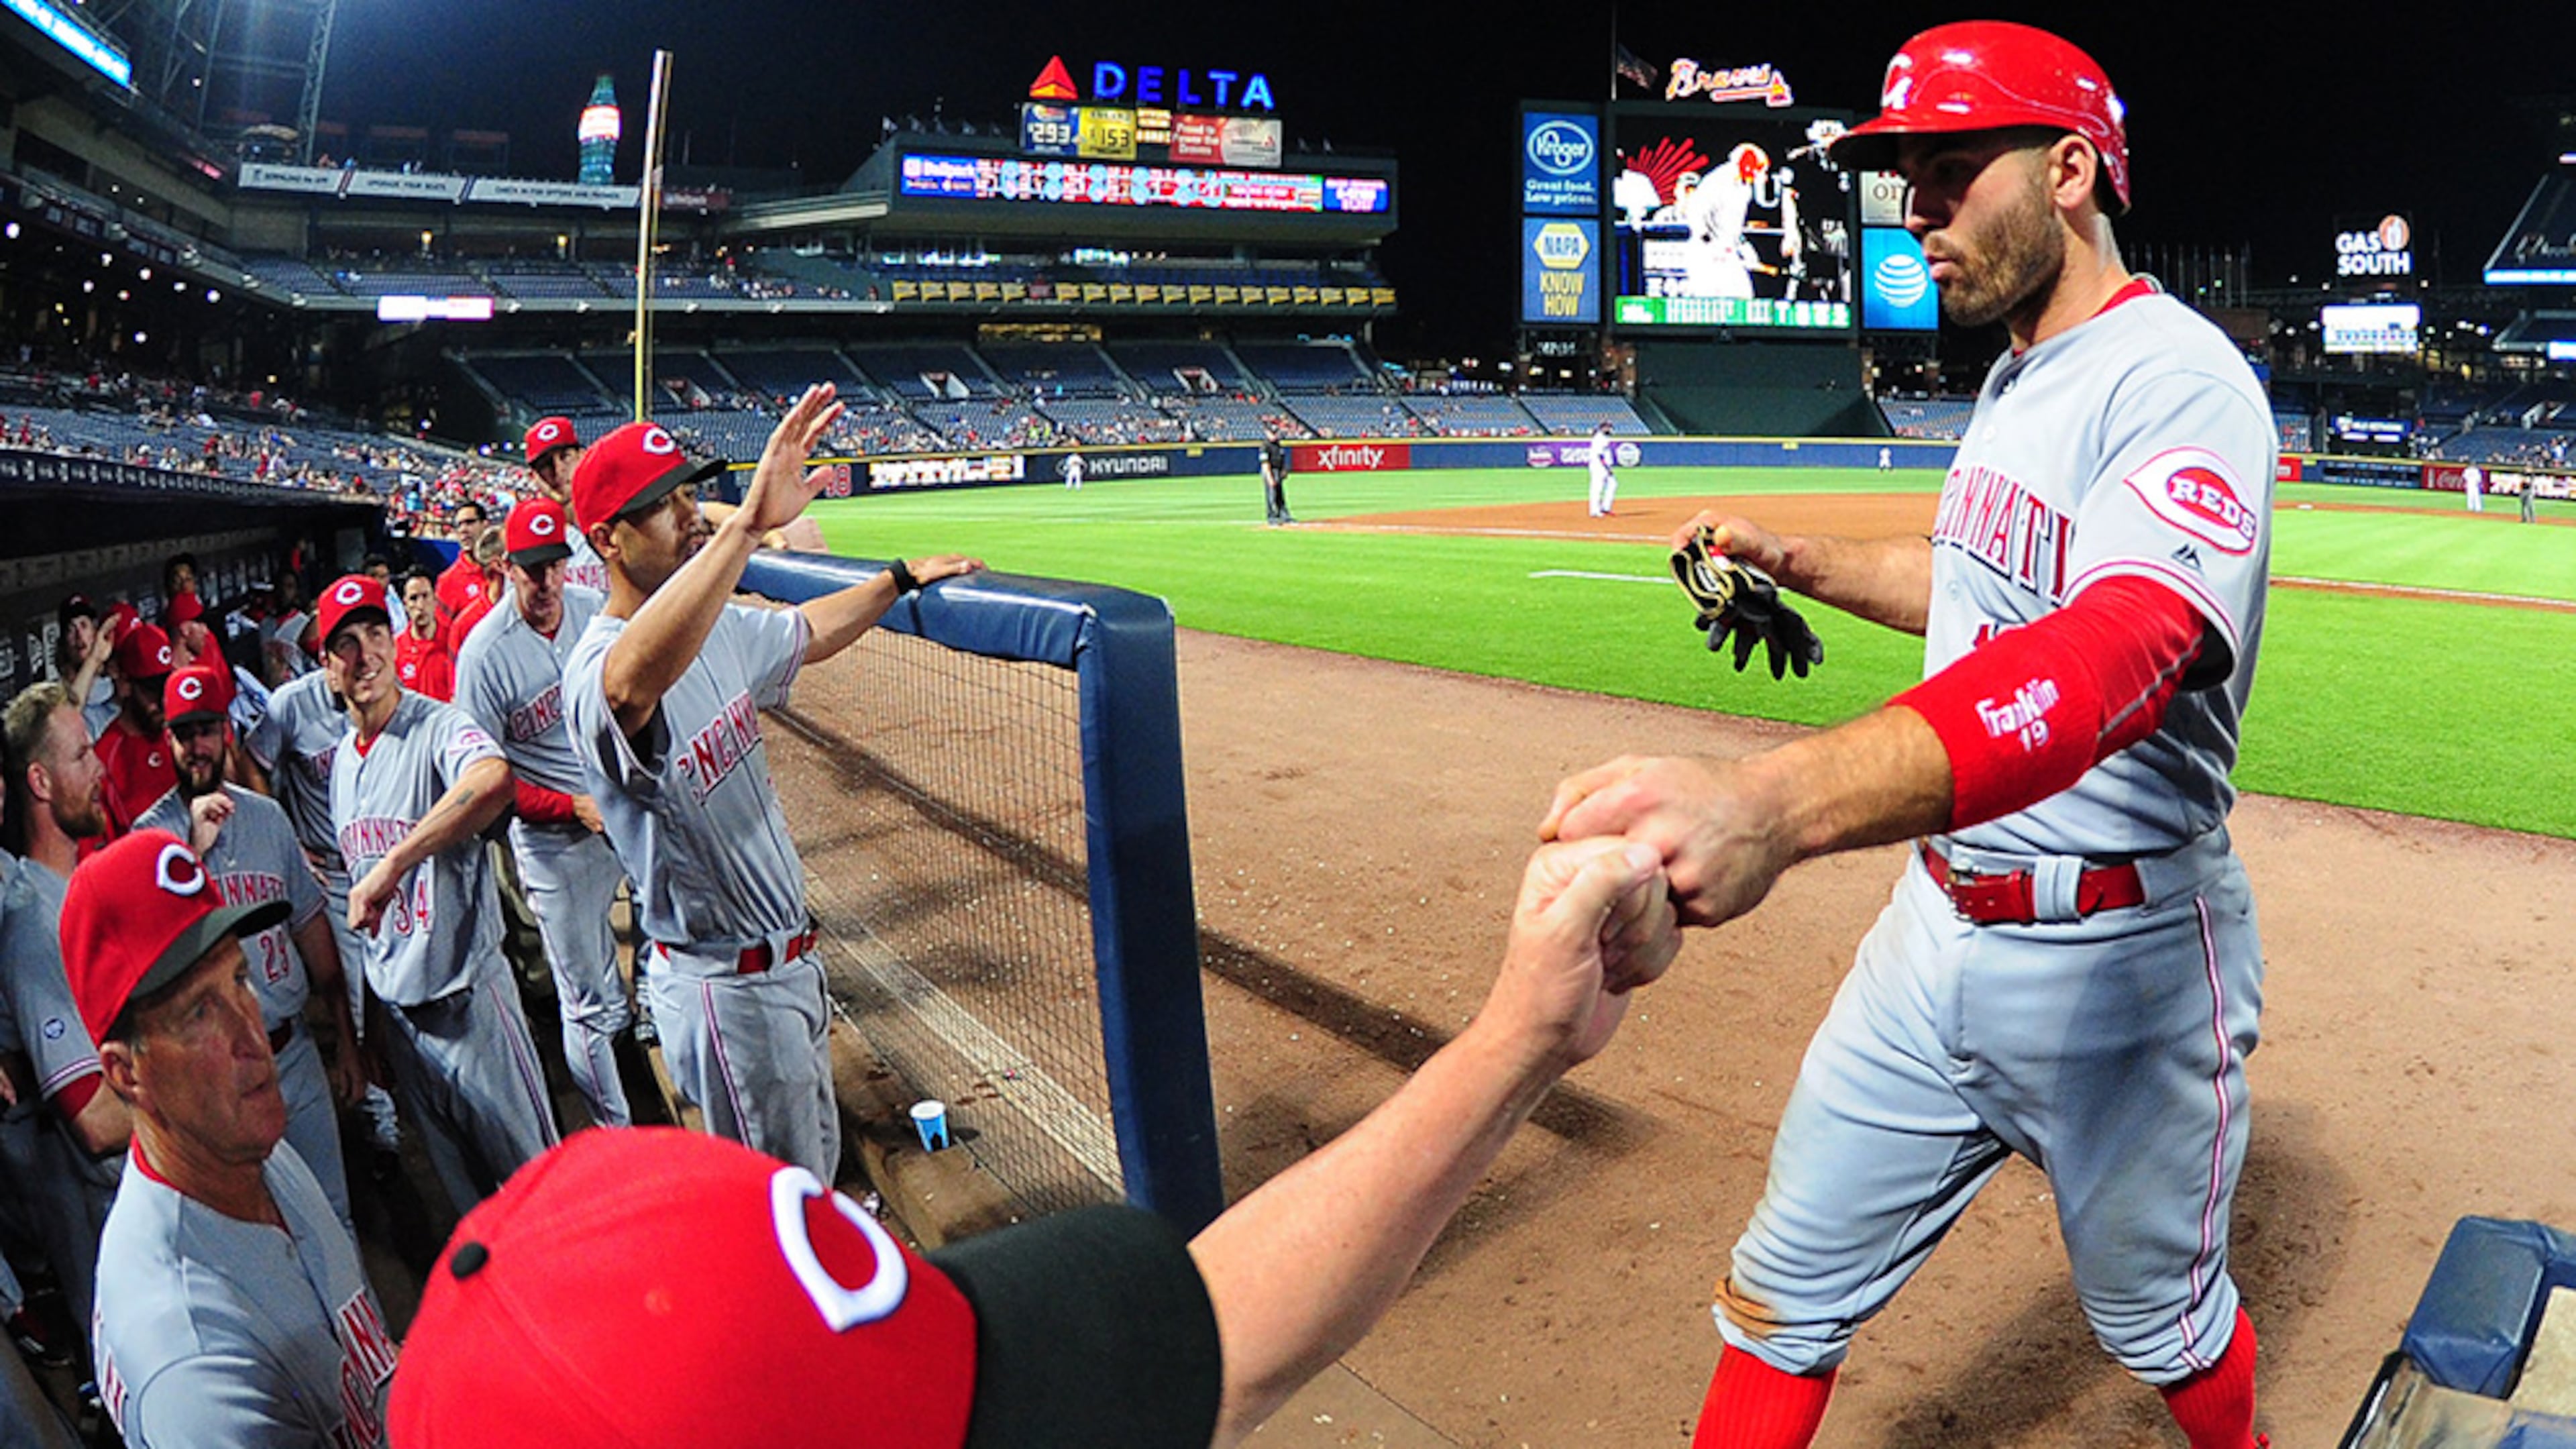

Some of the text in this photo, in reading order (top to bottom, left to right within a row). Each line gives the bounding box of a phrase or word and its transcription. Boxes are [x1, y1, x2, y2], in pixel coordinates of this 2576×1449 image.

[1093, 60, 1275, 111] DELTA
[1665, 58, 1772, 101] Braves
[1536, 129, 1587, 167] Kroger
[1526, 178, 1562, 191] Great
[1525, 191, 1552, 203] Low
[1544, 236, 1580, 256] NAPA
[2334, 231, 2381, 254] GAS
[2337, 252, 2411, 276] SOUTH
[1540, 271, 1585, 295] KNOW
[1544, 294, 1579, 317] HOW
[537, 423, 559, 441] C
[642, 427, 676, 455] C
[1089, 457, 1169, 475] HYUNDAI
[1318, 445, 1385, 470] xfinity
[2169, 476, 2256, 541] REDS
[529, 514, 556, 536] C
[335, 582, 364, 604] C
[178, 676, 202, 700] C
[1976, 678, 2060, 737] Franklin
[2020, 720, 2049, 753] 19
[156, 842, 205, 896] C
[394, 879, 430, 935] 34
[769, 1166, 909, 1334] C
